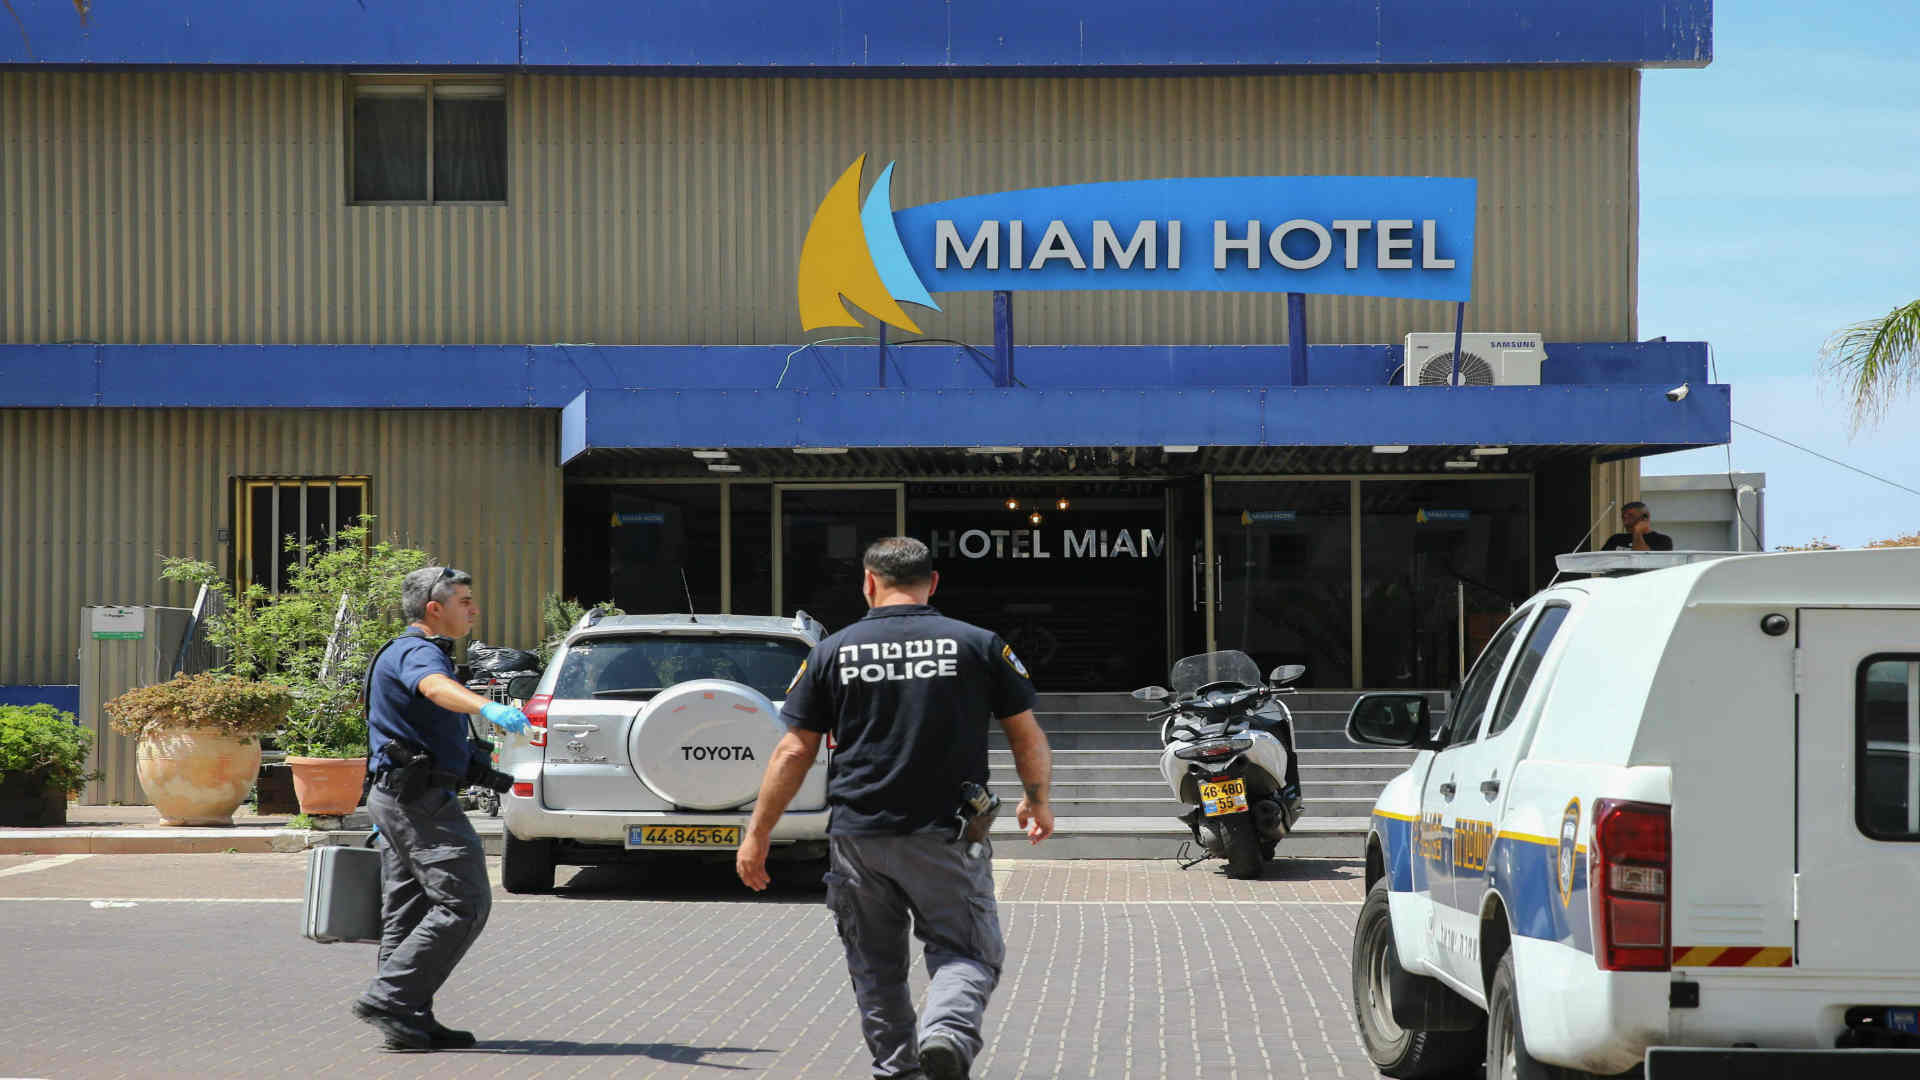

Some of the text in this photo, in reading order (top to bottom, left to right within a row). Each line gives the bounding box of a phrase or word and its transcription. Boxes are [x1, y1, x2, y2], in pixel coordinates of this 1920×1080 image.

[935, 219, 1457, 270] MIAMI HOTEL
[1489, 341, 1537, 349] SAMSUNG
[930, 528, 1051, 559] HOTEL
[839, 638, 959, 664] משטרה
[840, 659, 958, 685] POLICE
[681, 746, 755, 761] TOYOTA
